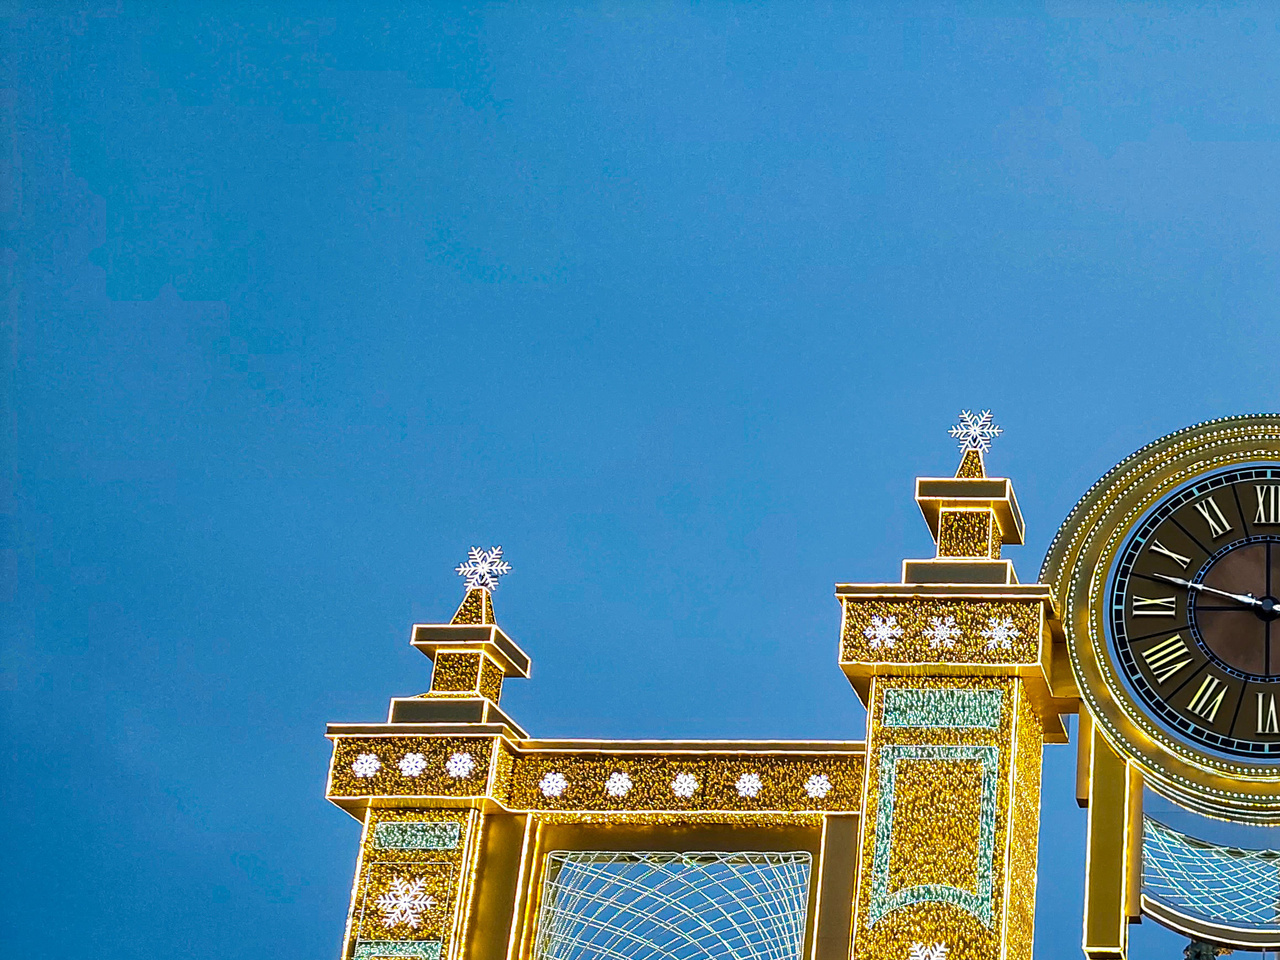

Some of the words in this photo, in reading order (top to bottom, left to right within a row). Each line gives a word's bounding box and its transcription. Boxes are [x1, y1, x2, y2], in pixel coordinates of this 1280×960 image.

[1194, 496, 1233, 538] XI
[1149, 538, 1192, 569] X
[1132, 594, 1176, 617] IX
[1141, 632, 1194, 684] VIII
[1185, 673, 1229, 723] VII
[1255, 691, 1280, 734] VI
